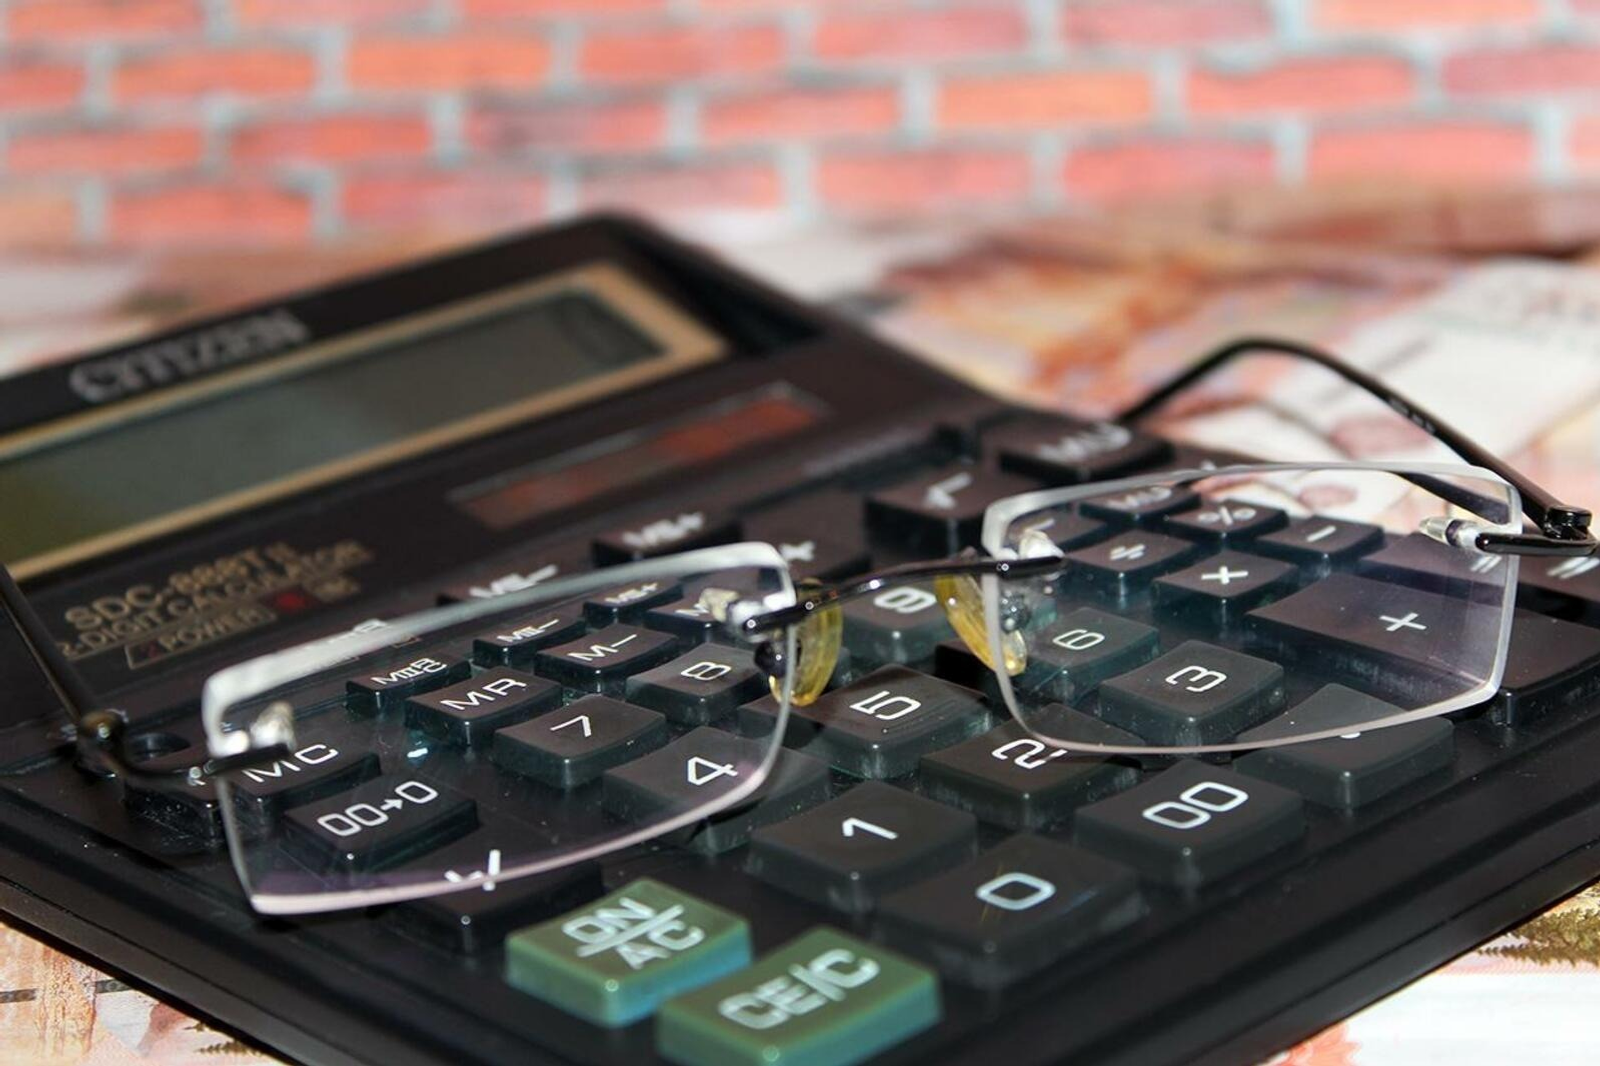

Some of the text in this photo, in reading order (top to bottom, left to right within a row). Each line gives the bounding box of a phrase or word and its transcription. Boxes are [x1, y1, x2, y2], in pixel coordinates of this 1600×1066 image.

[1052, 628, 1106, 652] 6
[679, 660, 732, 683] 8
[1165, 665, 1227, 693] 3
[440, 678, 527, 711] MR
[849, 689, 922, 722] 5
[550, 714, 592, 738] 7
[243, 744, 338, 783] MC
[991, 738, 1069, 770] 2
[686, 755, 738, 787] 4
[1142, 781, 1249, 829] 00
[841, 816, 898, 841] 1
[974, 872, 1056, 911] 0
